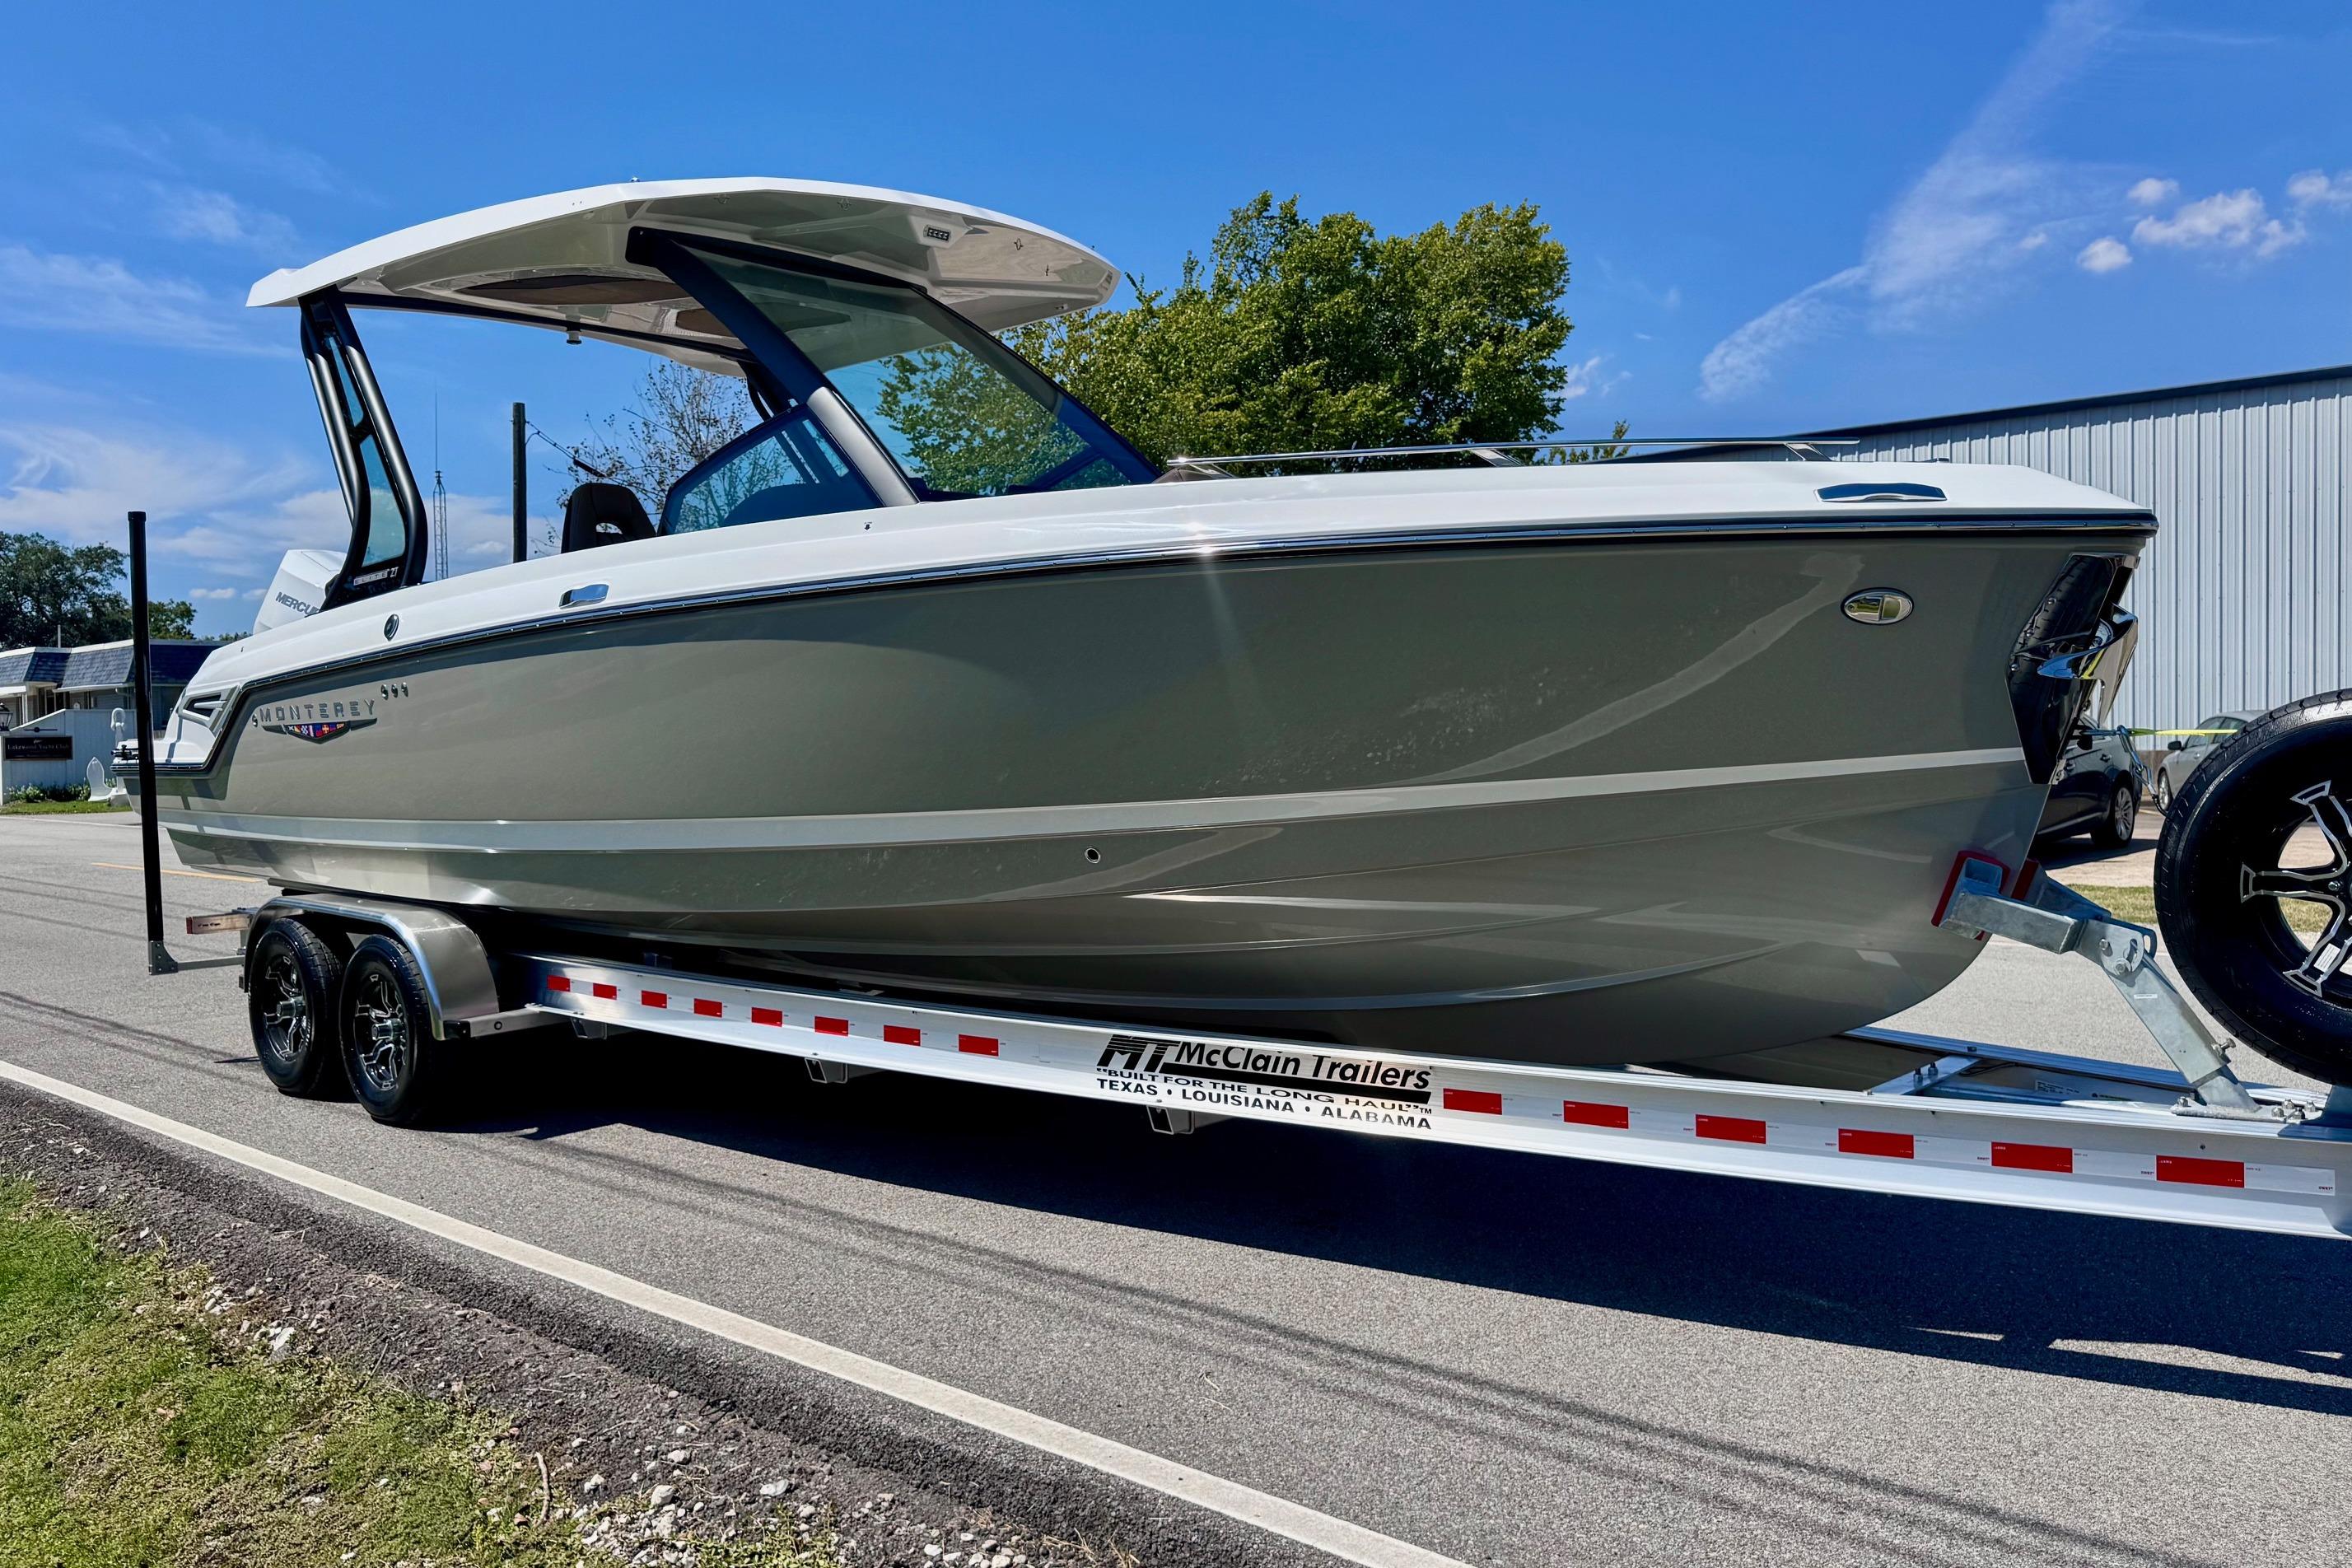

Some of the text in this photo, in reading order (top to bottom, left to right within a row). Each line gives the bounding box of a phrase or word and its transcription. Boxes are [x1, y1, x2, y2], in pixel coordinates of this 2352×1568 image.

[354, 567, 399, 585] ELITE 27
[275, 591, 320, 615] MERCU
[259, 699, 375, 722] MONTEREY
[1174, 1041, 1300, 1075] McClain
[1312, 1054, 1432, 1090] Trailers
[1164, 1076, 1204, 1088] FOR
[1209, 1081, 1248, 1094] THE
[1256, 1087, 1335, 1104] LONG
[1097, 1078, 1432, 1130] TEXAS LOUISIANA ALABAMA
